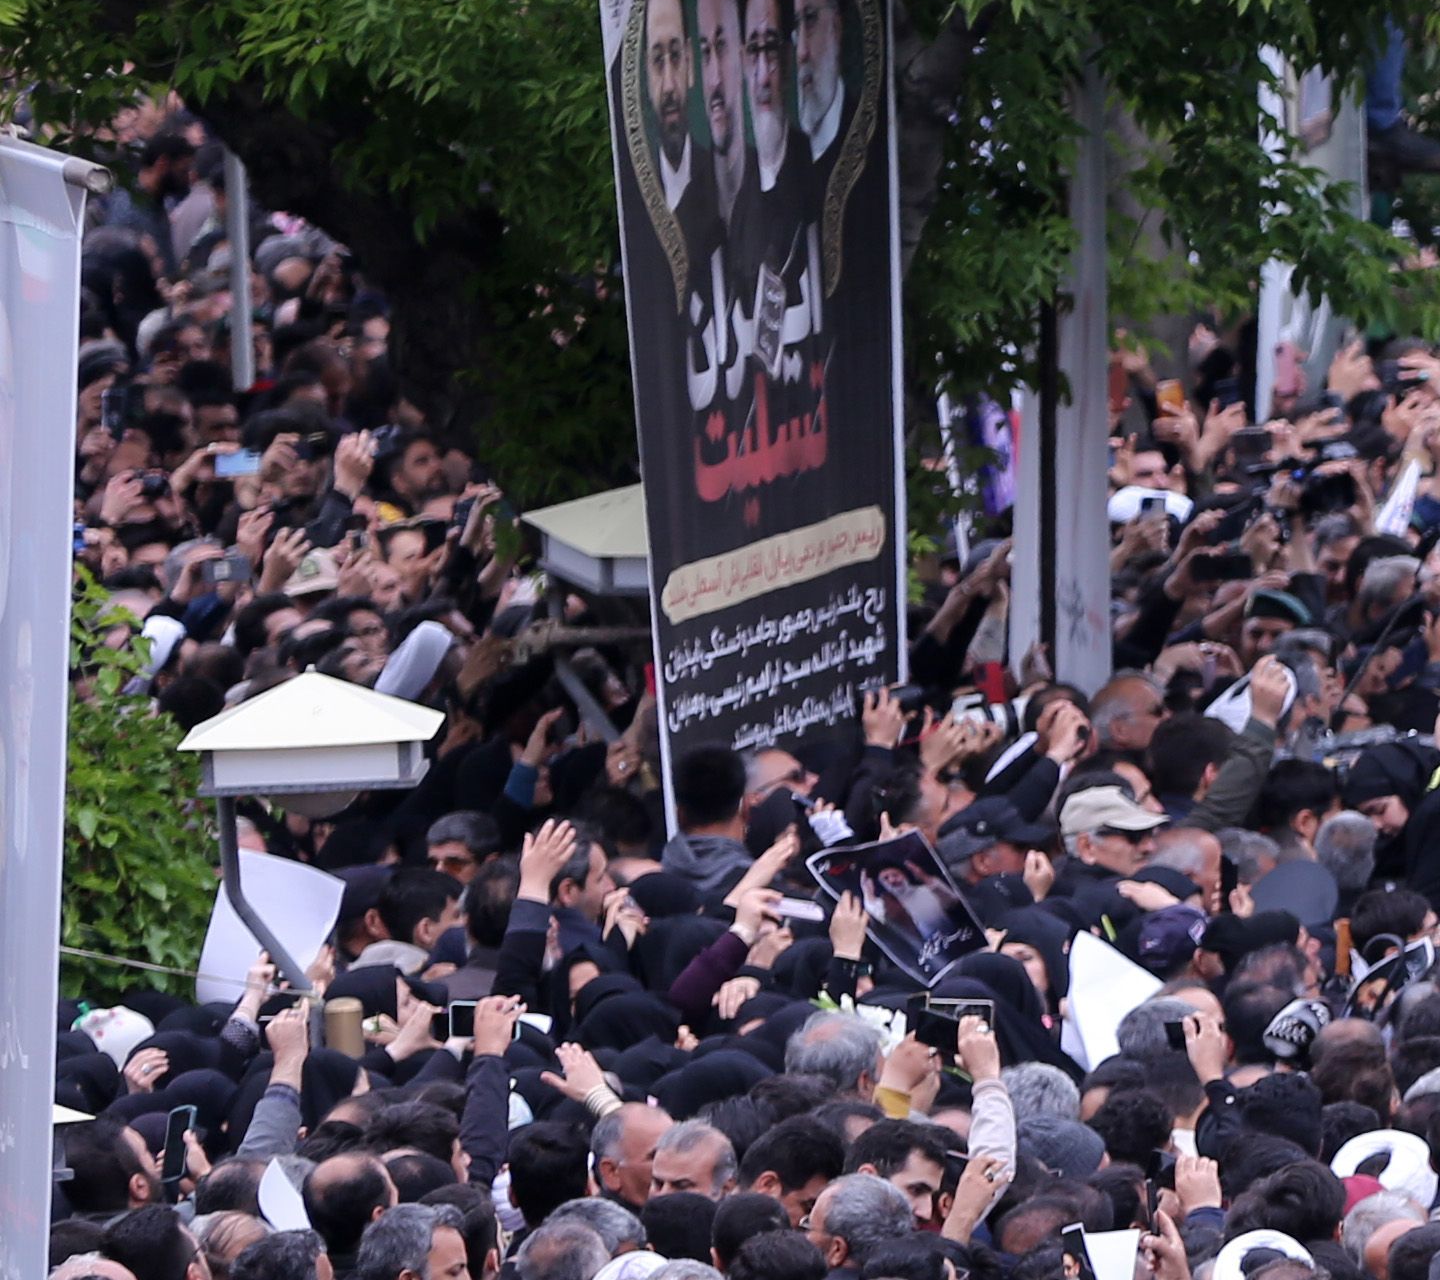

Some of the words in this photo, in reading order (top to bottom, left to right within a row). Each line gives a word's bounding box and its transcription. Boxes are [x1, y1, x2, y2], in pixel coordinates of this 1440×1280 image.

[686, 221, 823, 411] ایران
[694, 361, 828, 527] تسلیت
[848, 622, 887, 664] شهید
